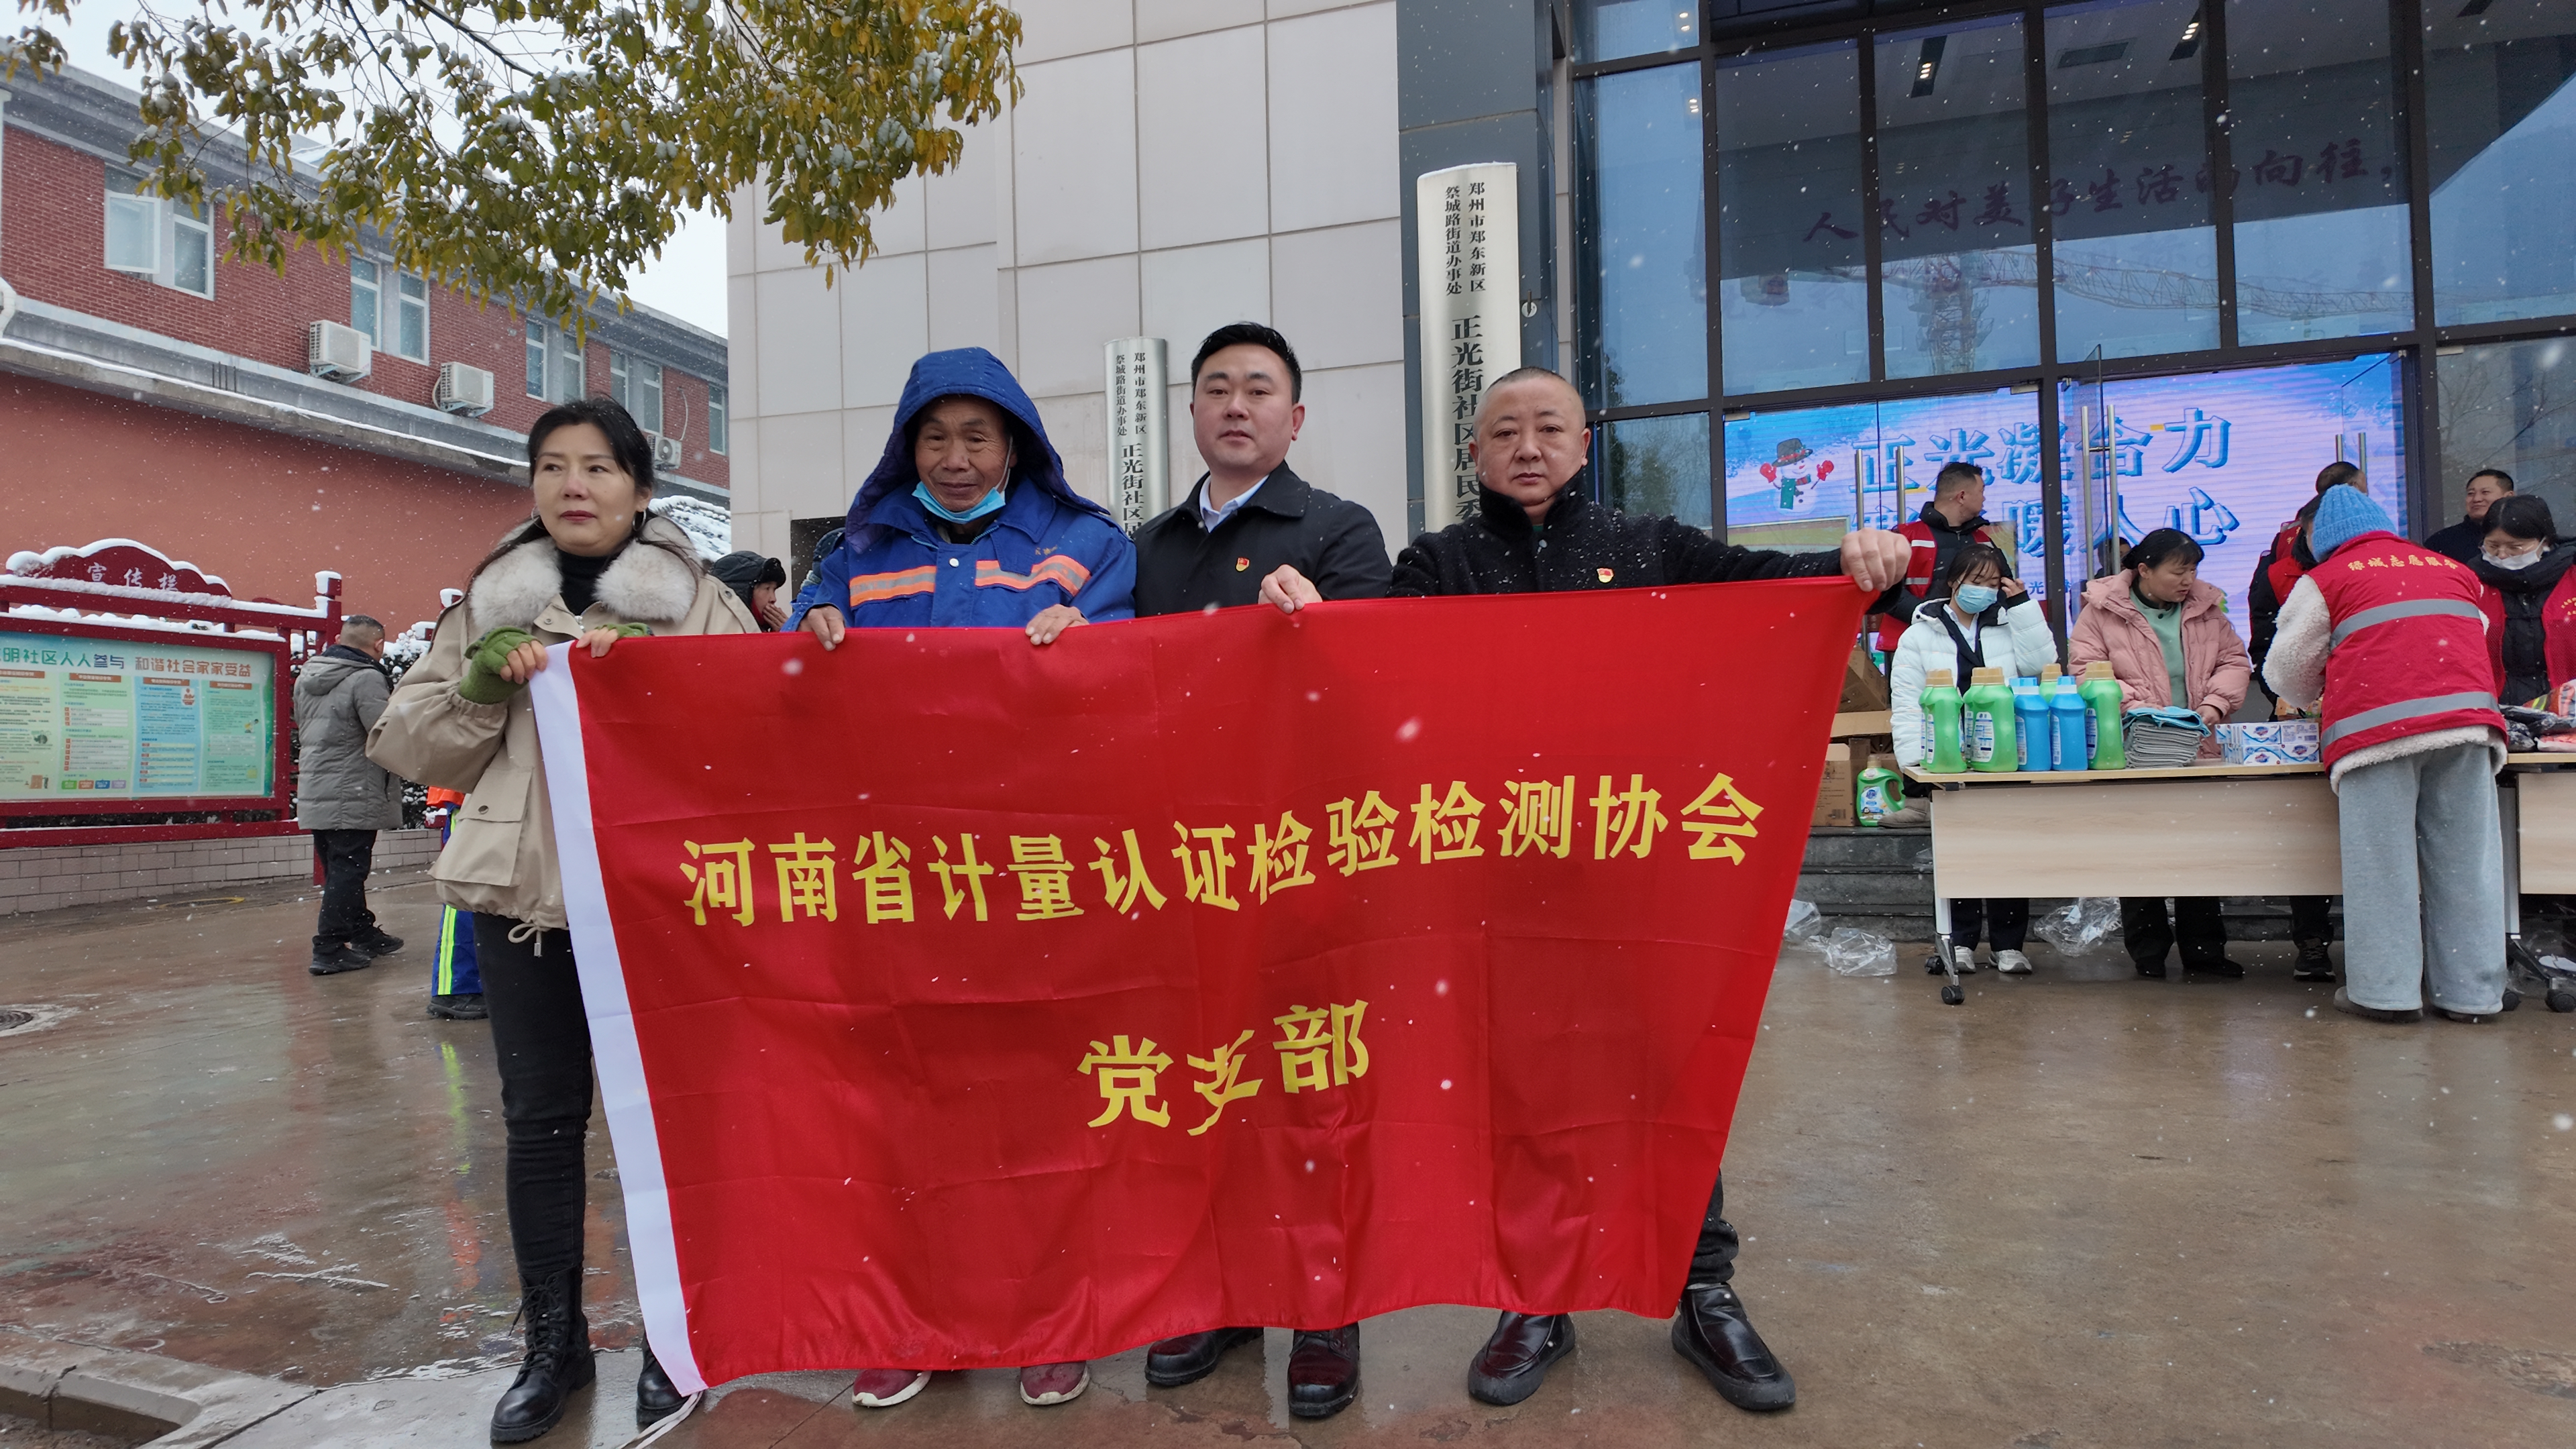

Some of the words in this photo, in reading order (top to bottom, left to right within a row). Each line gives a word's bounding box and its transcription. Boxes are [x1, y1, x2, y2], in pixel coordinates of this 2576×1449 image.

[1445, 185, 1462, 297] 祭城路街道办事处
[1468, 182, 1486, 292] 郑州市郑东新区
[1116, 354, 1127, 436] 祭城路街道办事处
[1134, 352, 1146, 434] 郑州市郑东新区
[87, 561, 178, 592] 宣传栏
[0, 647, 124, 669] 明社区人人参与
[135, 657, 251, 677] 和谐社会家家受益
[680, 772, 1764, 927] 河南省计量认证检验检测协会
[1077, 999, 1369, 1136] 党支部
